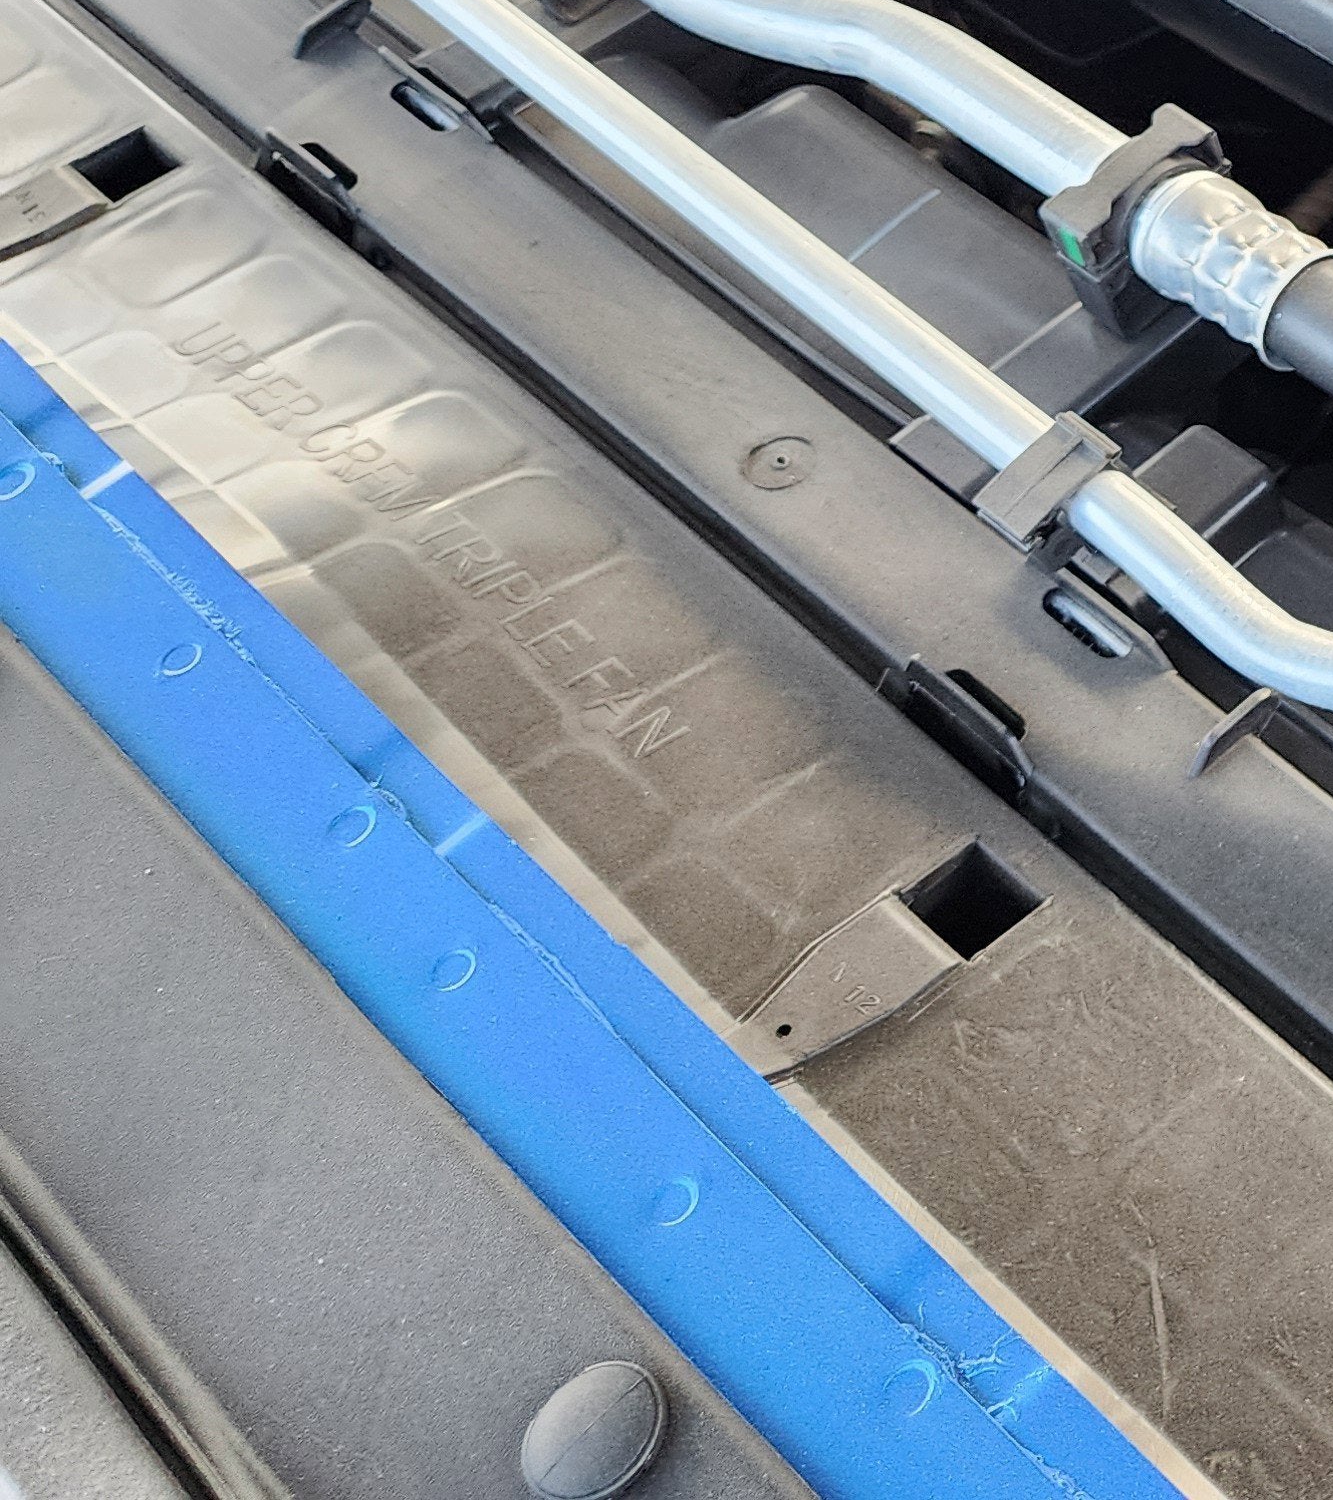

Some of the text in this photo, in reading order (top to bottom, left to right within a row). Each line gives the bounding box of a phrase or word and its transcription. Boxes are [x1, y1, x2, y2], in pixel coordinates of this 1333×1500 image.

[172, 321, 694, 759] UPPER CRFM TRIPLE FAN
[844, 985, 881, 1015] 12
